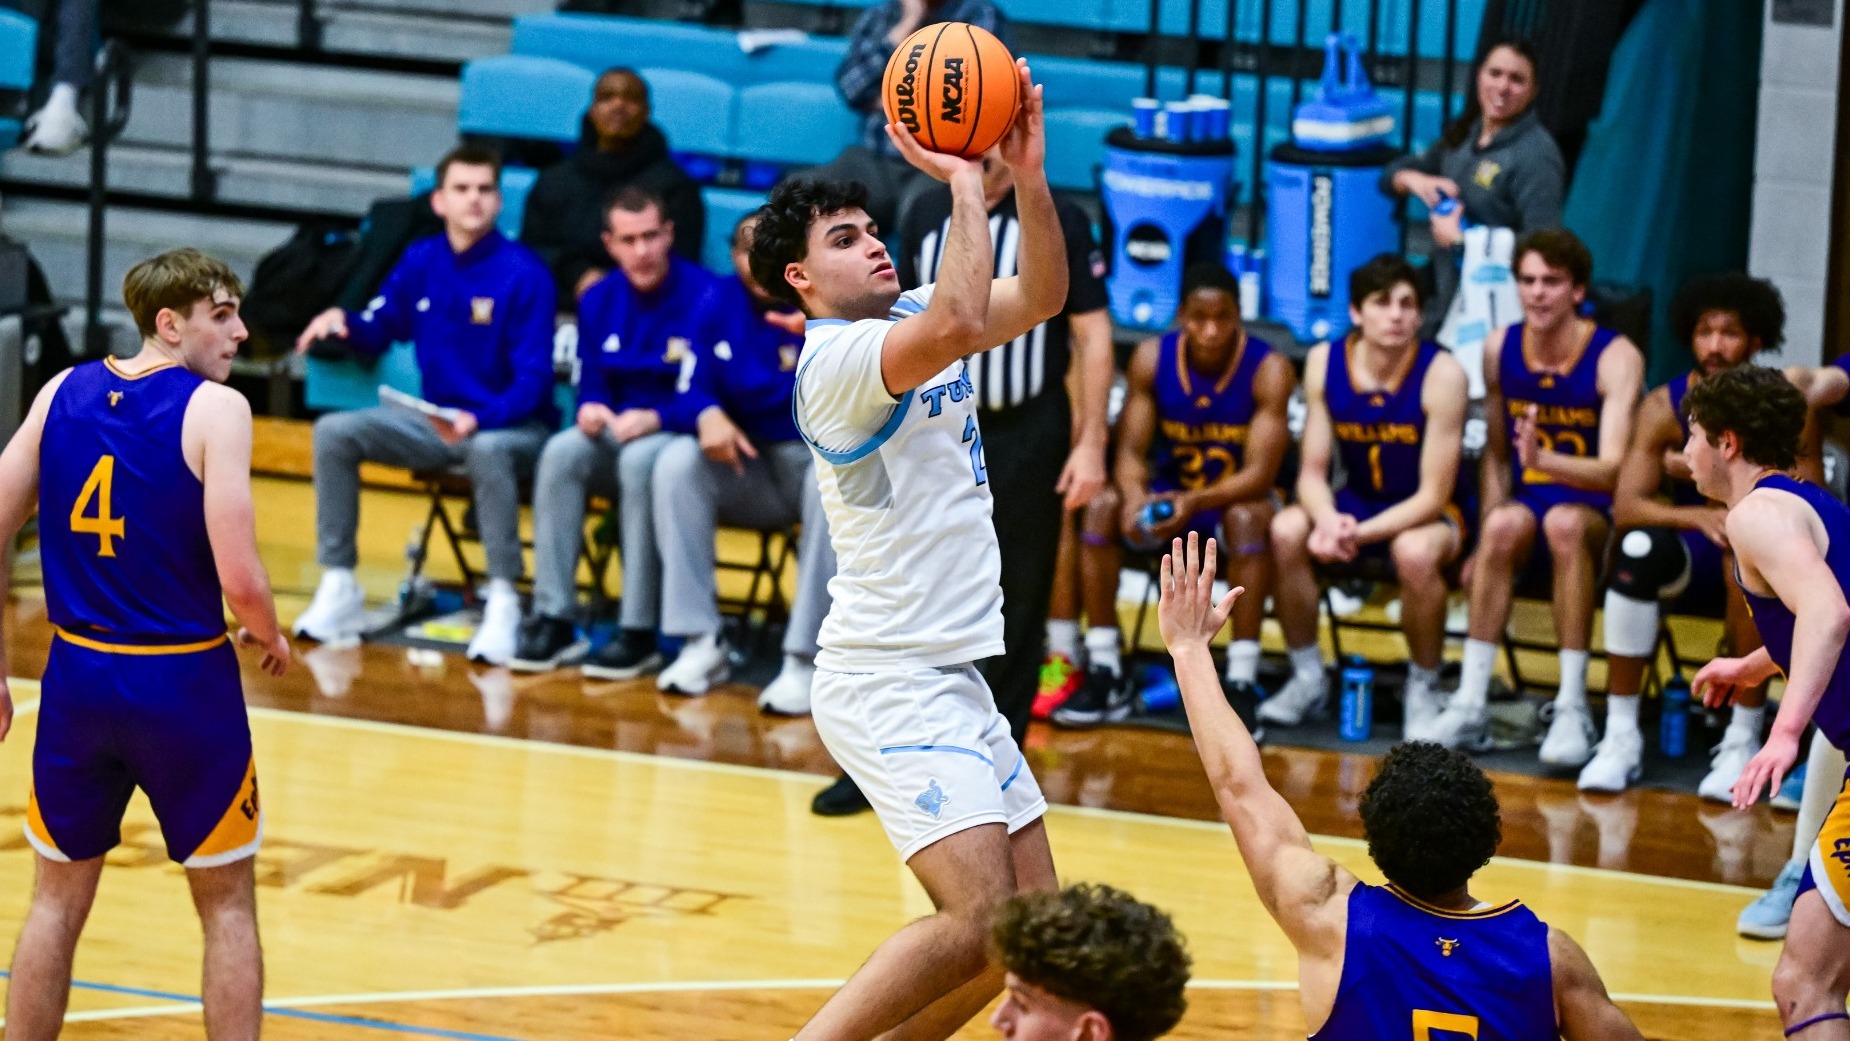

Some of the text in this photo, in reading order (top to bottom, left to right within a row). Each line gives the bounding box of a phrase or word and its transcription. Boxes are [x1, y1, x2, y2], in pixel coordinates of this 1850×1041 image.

[896, 44, 927, 133] Wilson
[941, 58, 963, 124] NCAA
[1334, 422, 1419, 445] WILLIAMS
[1368, 444, 1383, 492] 1
[70, 454, 126, 558] 4
